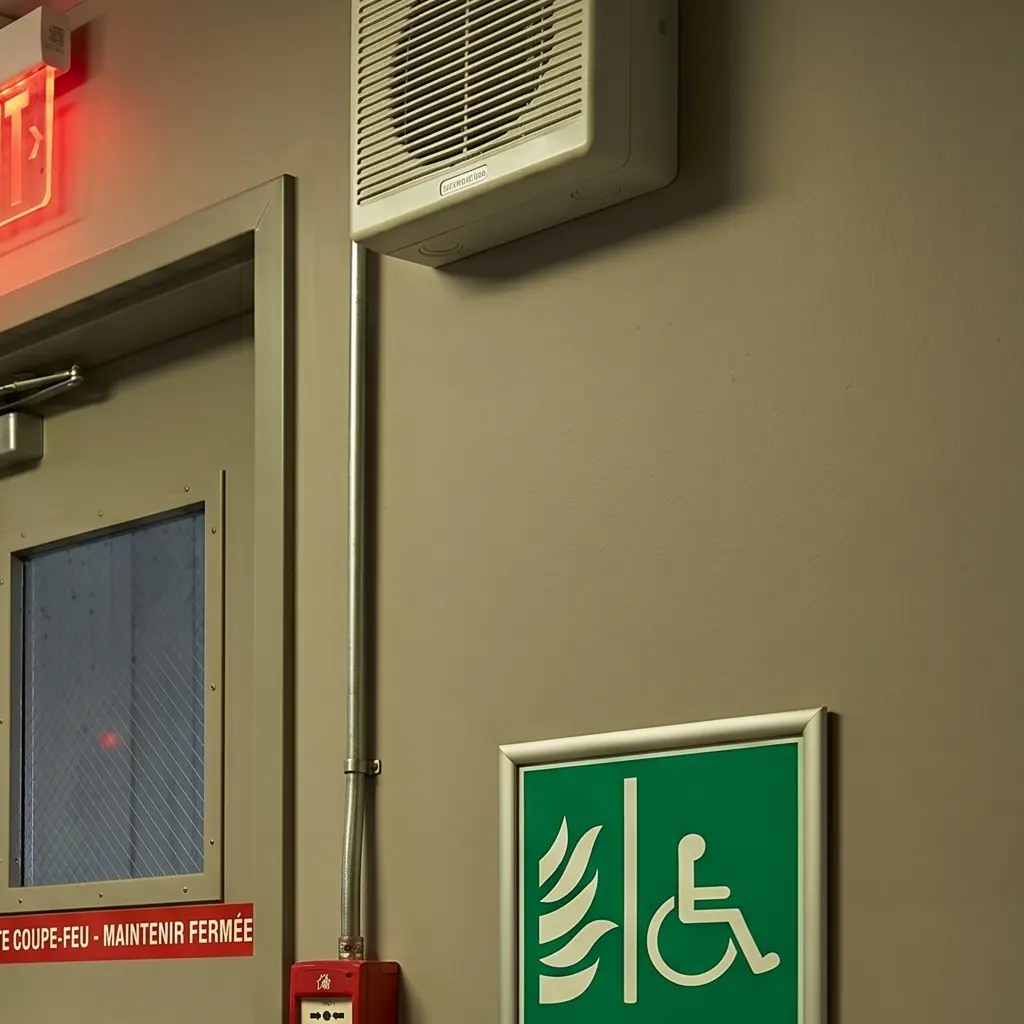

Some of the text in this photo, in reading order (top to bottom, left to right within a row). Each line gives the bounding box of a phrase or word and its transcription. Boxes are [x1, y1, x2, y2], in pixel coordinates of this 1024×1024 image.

[13, 926, 90, 951] COUPE-FEU
[103, 922, 185, 947] MAINTENIR
[189, 912, 253, 944] FERMÉE
